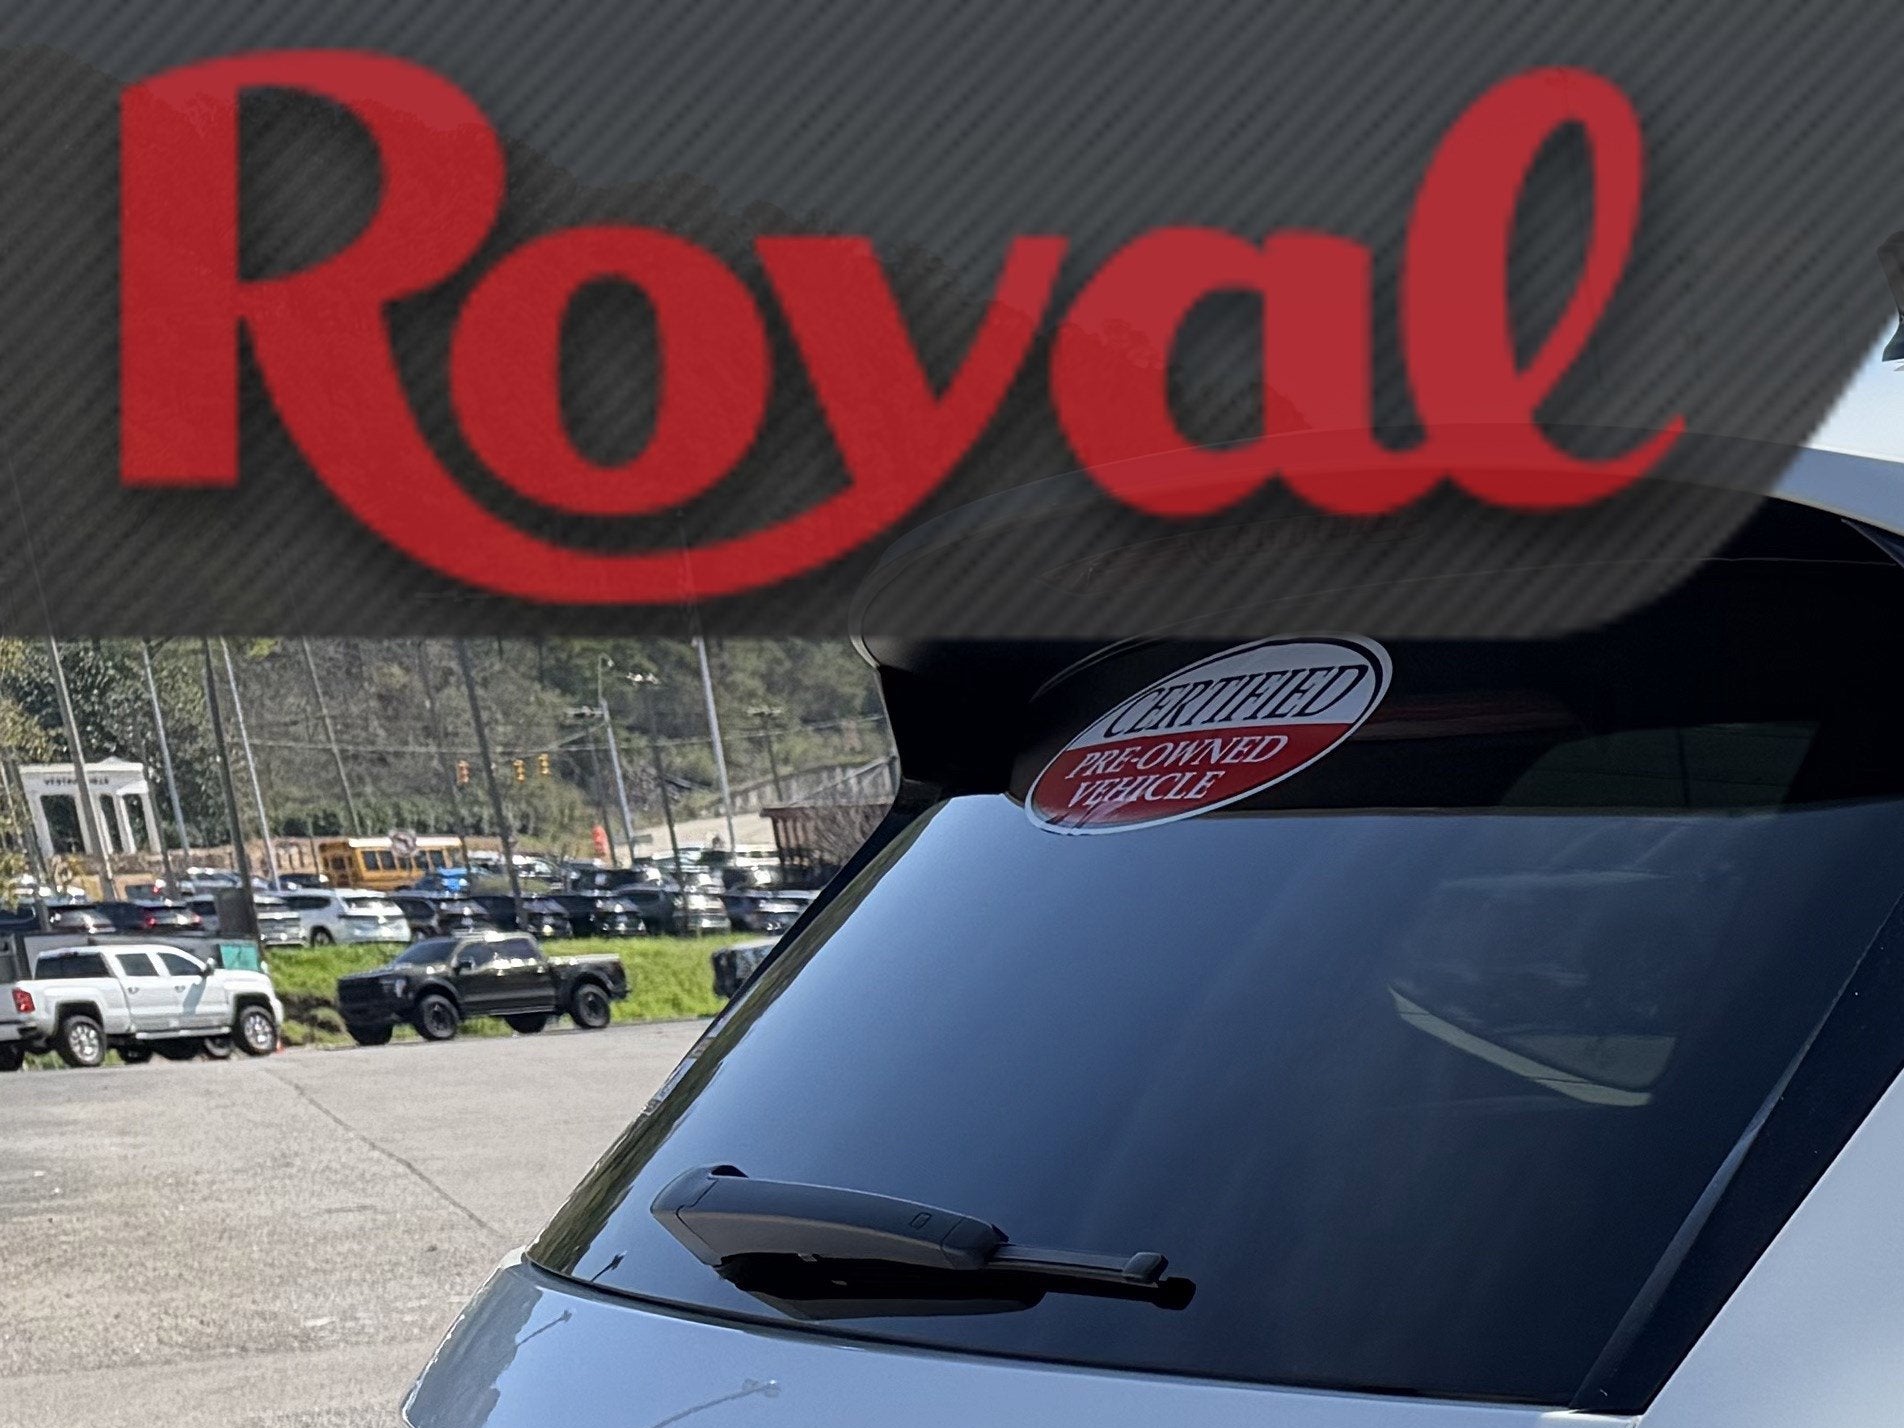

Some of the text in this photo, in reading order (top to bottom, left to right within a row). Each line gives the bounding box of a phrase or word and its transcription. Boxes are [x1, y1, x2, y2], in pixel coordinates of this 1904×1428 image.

[1103, 663, 1371, 738] CERTIFIED
[1064, 734, 1289, 780] PRE-OWNED
[1066, 769, 1226, 809] VEHICLE
